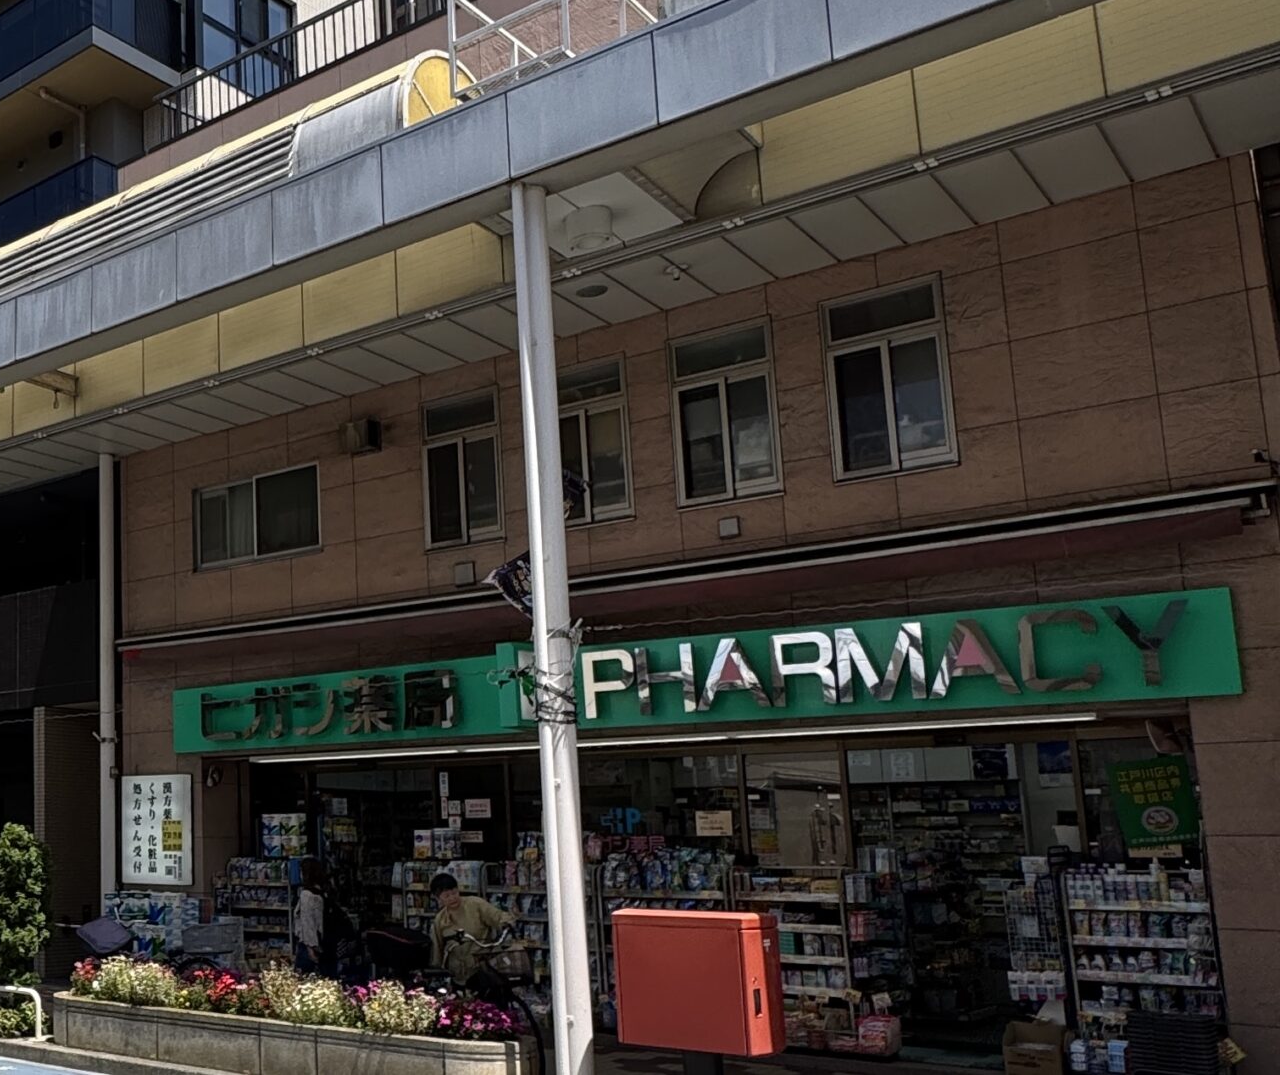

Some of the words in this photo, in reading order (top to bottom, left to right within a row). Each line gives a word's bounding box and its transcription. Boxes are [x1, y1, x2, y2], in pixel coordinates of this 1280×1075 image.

[201, 669, 456, 741] ヒガシ薬局
[581, 600, 1188, 720] PHARMACY
[132, 783, 142, 874] 処方せん受付
